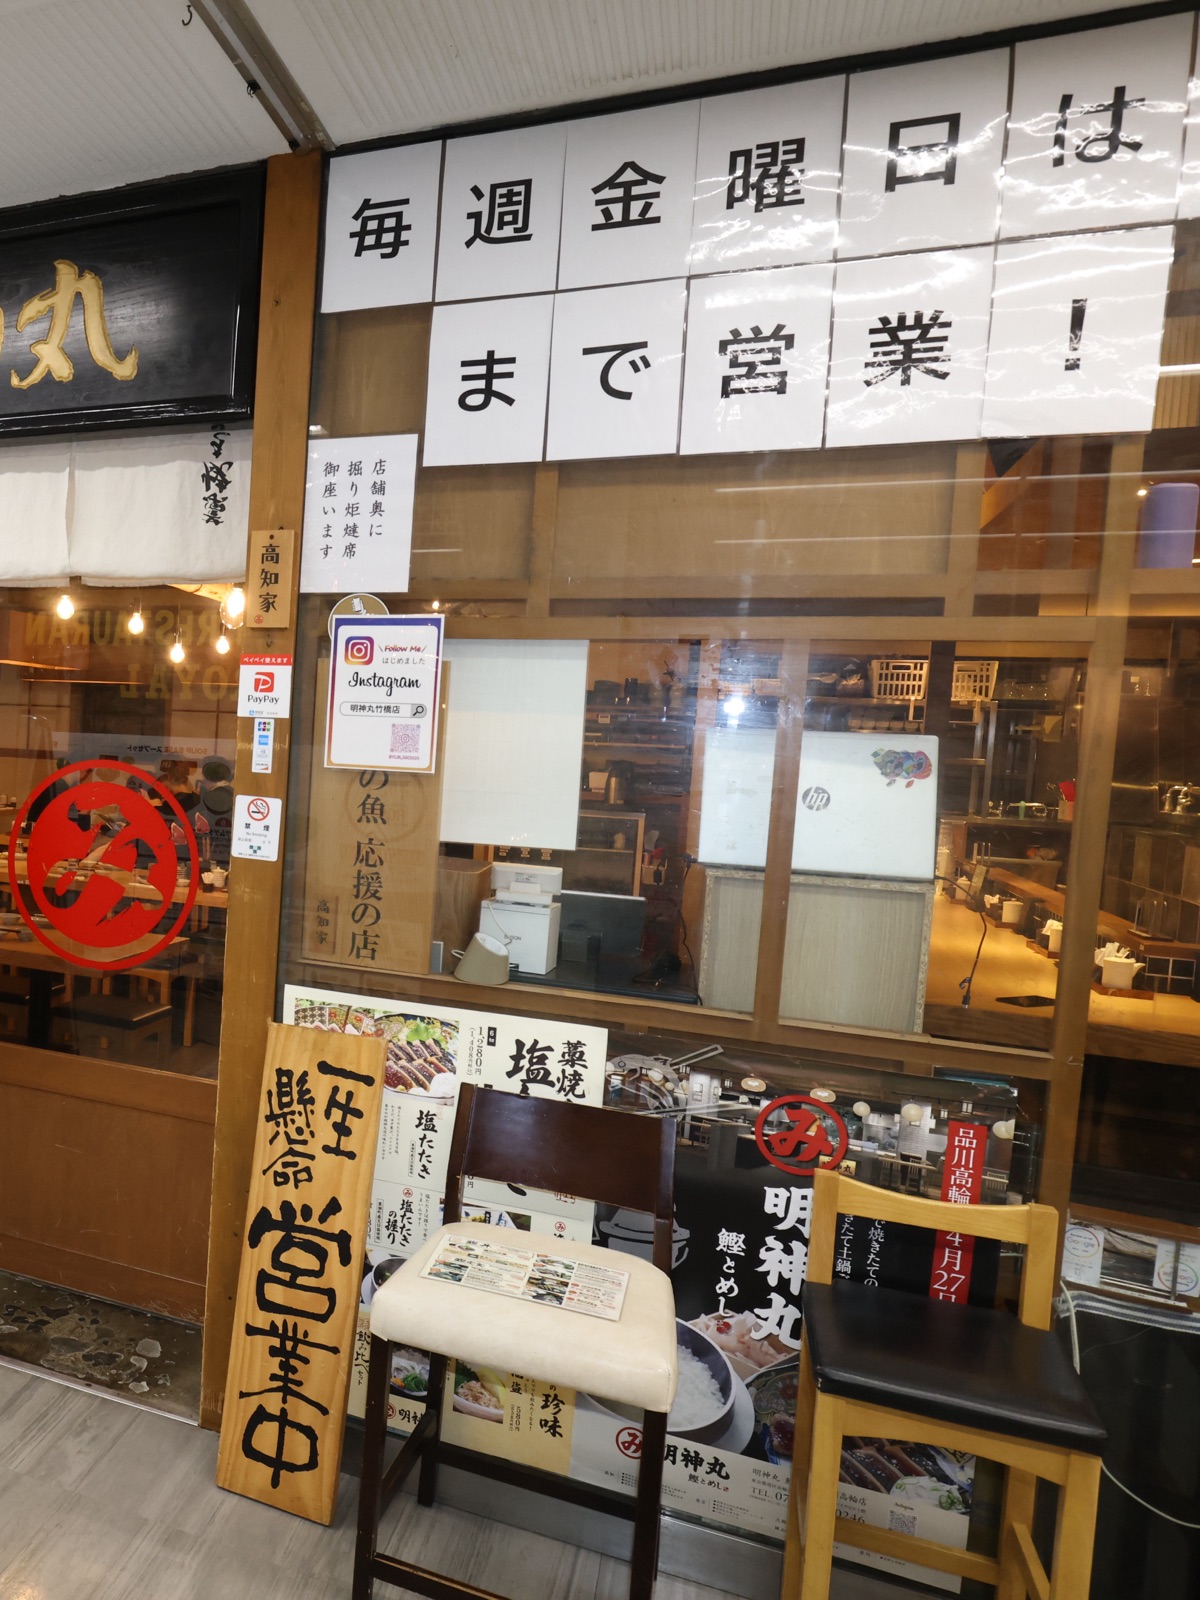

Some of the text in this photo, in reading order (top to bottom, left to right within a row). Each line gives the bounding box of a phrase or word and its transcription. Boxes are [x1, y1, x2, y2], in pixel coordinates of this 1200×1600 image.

[348, 85, 1147, 261] 毎週金曜日は
[457, 297, 1089, 413] まで営業！
[319, 461, 340, 559] 御座います
[341, 460, 363, 559] 掘り炬燵席
[369, 458, 387, 538] 店舗奥に
[258, 543, 281, 612] 高知家
[382, 657, 426, 665] はじめました
[410, 645, 422, 653] Me
[247, 694, 280, 705] PayPay
[348, 671, 421, 697] Instagram
[350, 704, 401, 714] 明神丸竹橋店
[245, 822, 270, 832] 禁煙
[803, 788, 830, 810] hp
[348, 837, 384, 962] 応援の店
[474, 1026, 485, 1076] 1,280円
[506, 1038, 556, 1096] 塩
[557, 1040, 588, 1103] 藁焼
[262, 1066, 316, 1188] 懸命
[317, 1060, 376, 1161] 一生
[767, 1107, 834, 1162] み
[415, 1109, 438, 1180] 塩たたき
[947, 1127, 978, 1205] 品川高輪
[384, 1210, 399, 1245] の握り
[399, 1199, 415, 1247] 塩たたき
[715, 1228, 747, 1318] 鰹とめし
[751, 1186, 815, 1350] 明神丸
[238, 1196, 353, 1489] 営業中
[354, 1330, 371, 1374] 飲み比べ
[539, 1384, 566, 1438] の珍味
[687, 1472, 723, 1491] 鰹とめし
